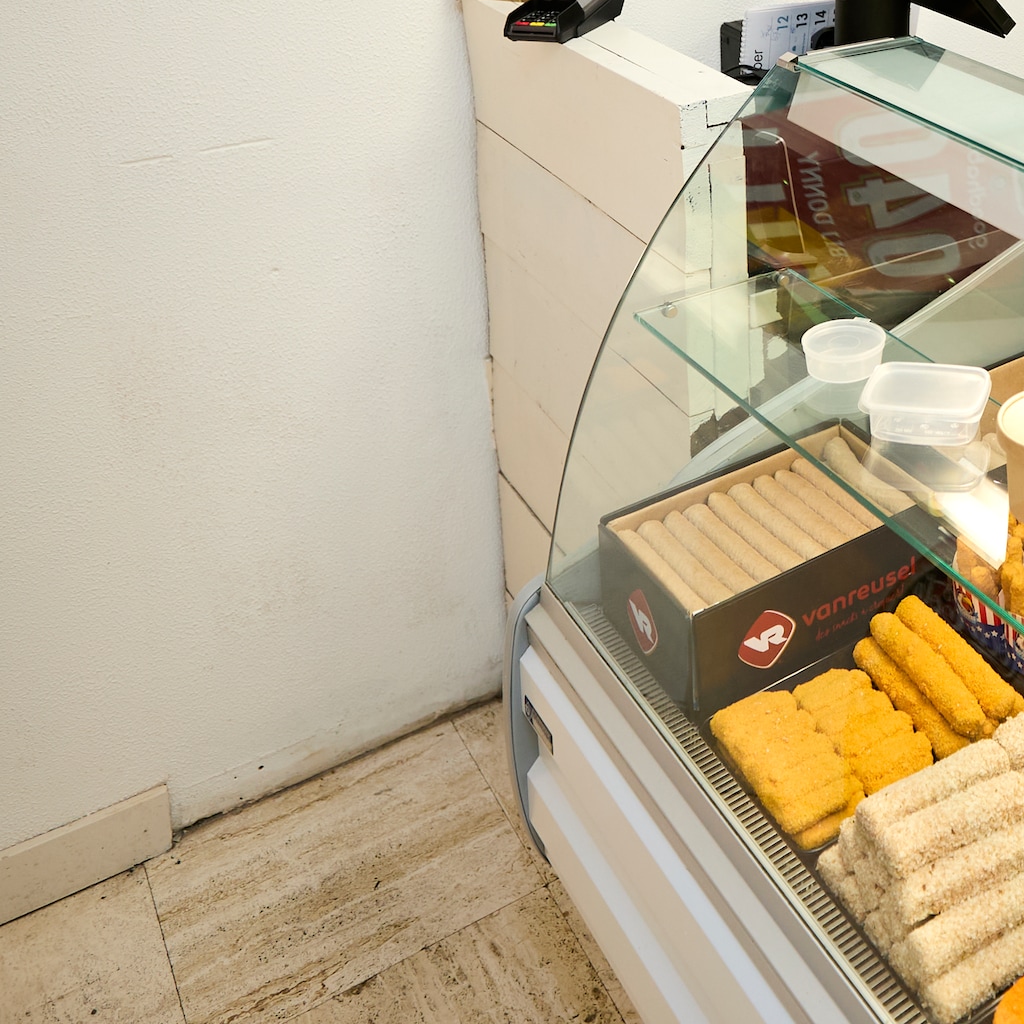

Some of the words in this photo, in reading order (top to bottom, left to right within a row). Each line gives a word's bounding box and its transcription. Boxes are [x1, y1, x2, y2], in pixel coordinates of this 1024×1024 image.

[777, 15, 789, 30] 12
[796, 13, 808, 28] 13
[815, 10, 826, 25] 14
[802, 556, 915, 626] vanreusel
